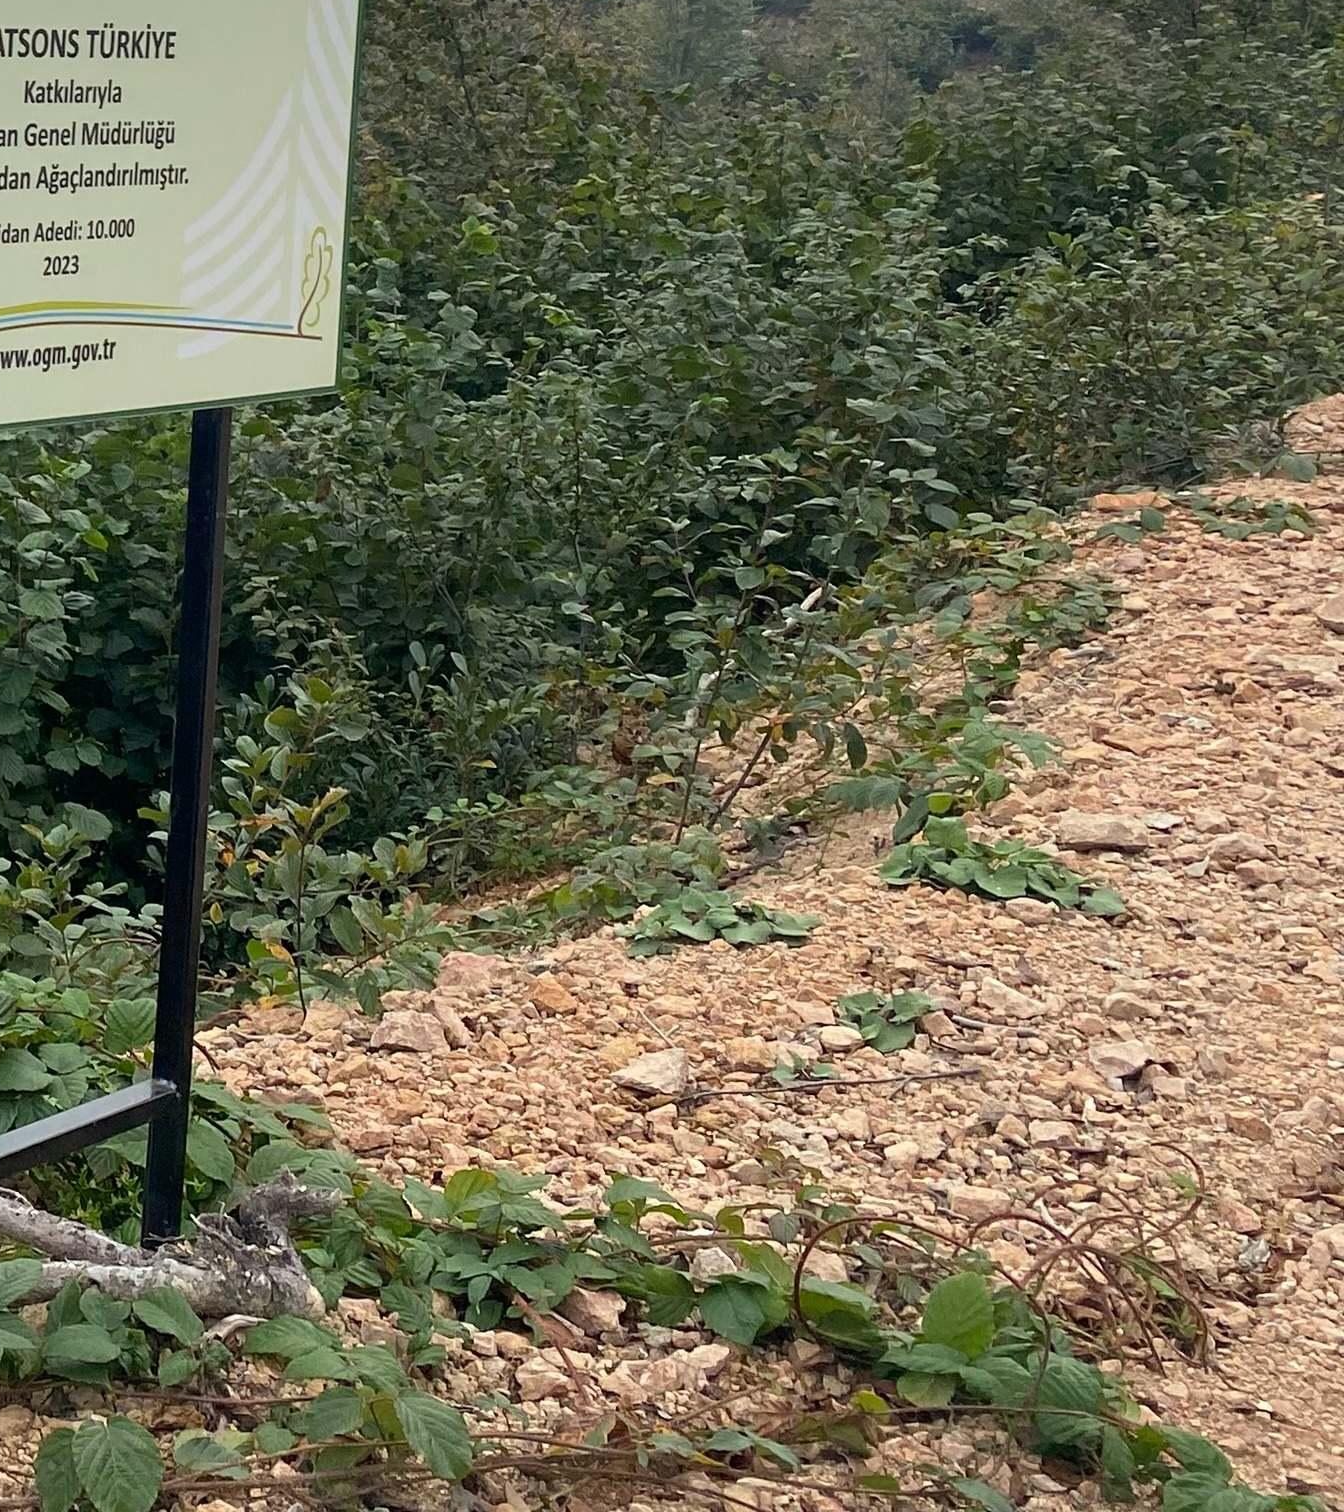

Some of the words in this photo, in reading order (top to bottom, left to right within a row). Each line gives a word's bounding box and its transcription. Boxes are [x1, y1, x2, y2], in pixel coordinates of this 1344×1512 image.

[87, 23, 177, 59] TÜRKİYE
[23, 79, 122, 109] Katkılarıyla
[24, 122, 76, 146] Genel
[81, 120, 175, 149] Müdürlüğü
[36, 162, 189, 194] Ağaçlandırılmıştır.
[33, 220, 82, 243] Adedi:
[87, 218, 135, 240] 10.000
[43, 255, 79, 276] 2023
